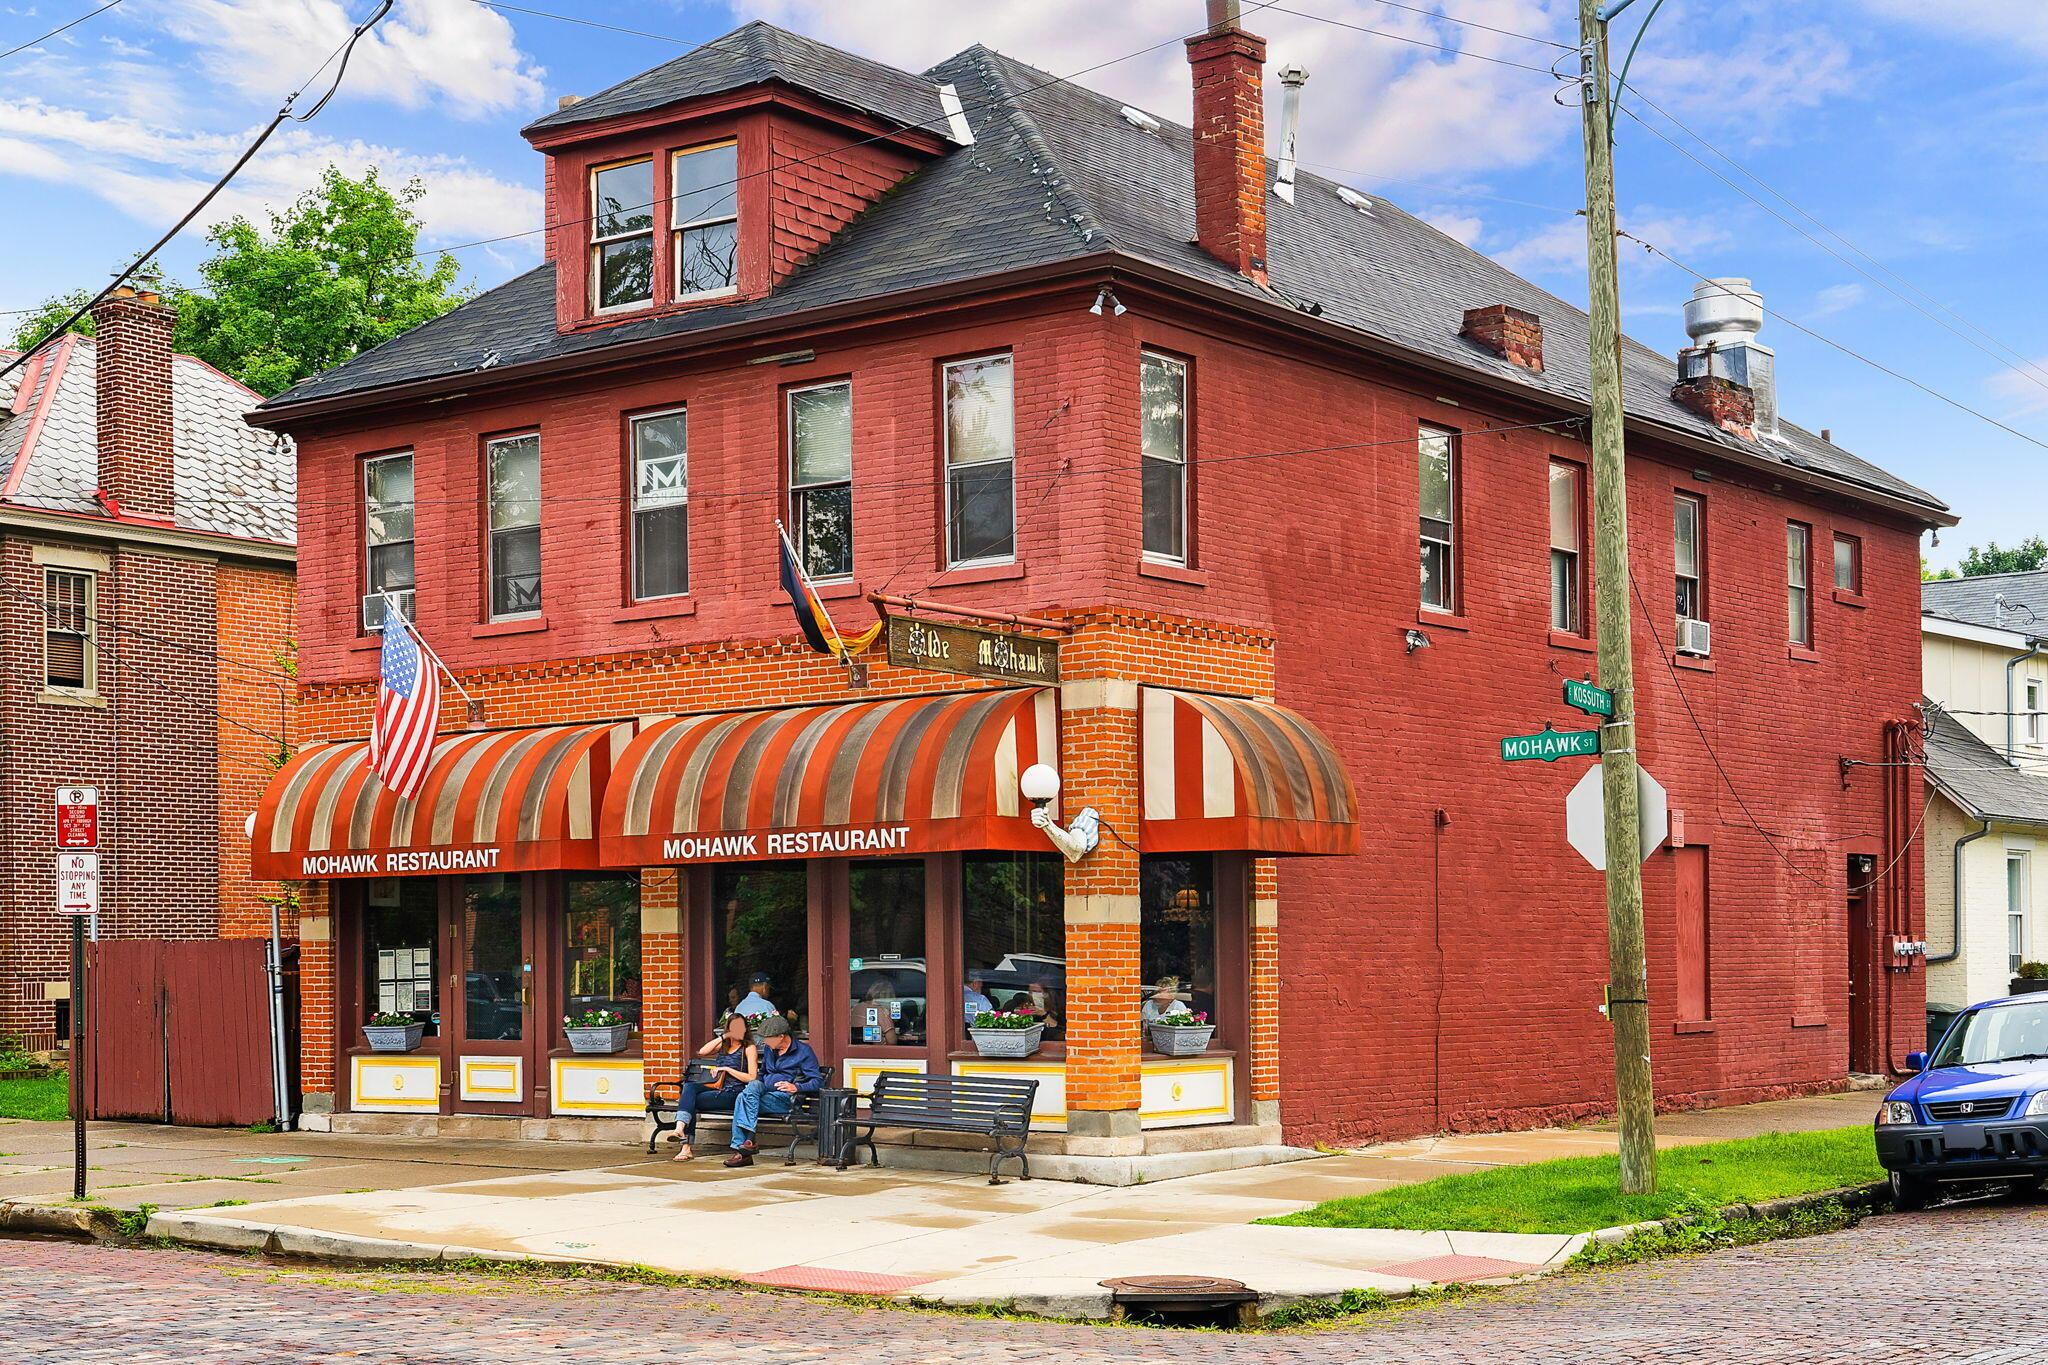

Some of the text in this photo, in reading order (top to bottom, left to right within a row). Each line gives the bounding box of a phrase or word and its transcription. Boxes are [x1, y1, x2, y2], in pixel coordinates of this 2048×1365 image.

[1573, 685, 1605, 709] KOSSUTH
[1505, 736, 1593, 757] MOHAWK ST
[663, 827, 910, 859] MOHAWK RESTAURANT
[71, 859, 84, 868] NO
[303, 849, 500, 875] MOHAWK RESTAURANT
[61, 870, 95, 880] STOPPING
[71, 882, 85, 890] ANY
[70, 891, 86, 899] TIME
